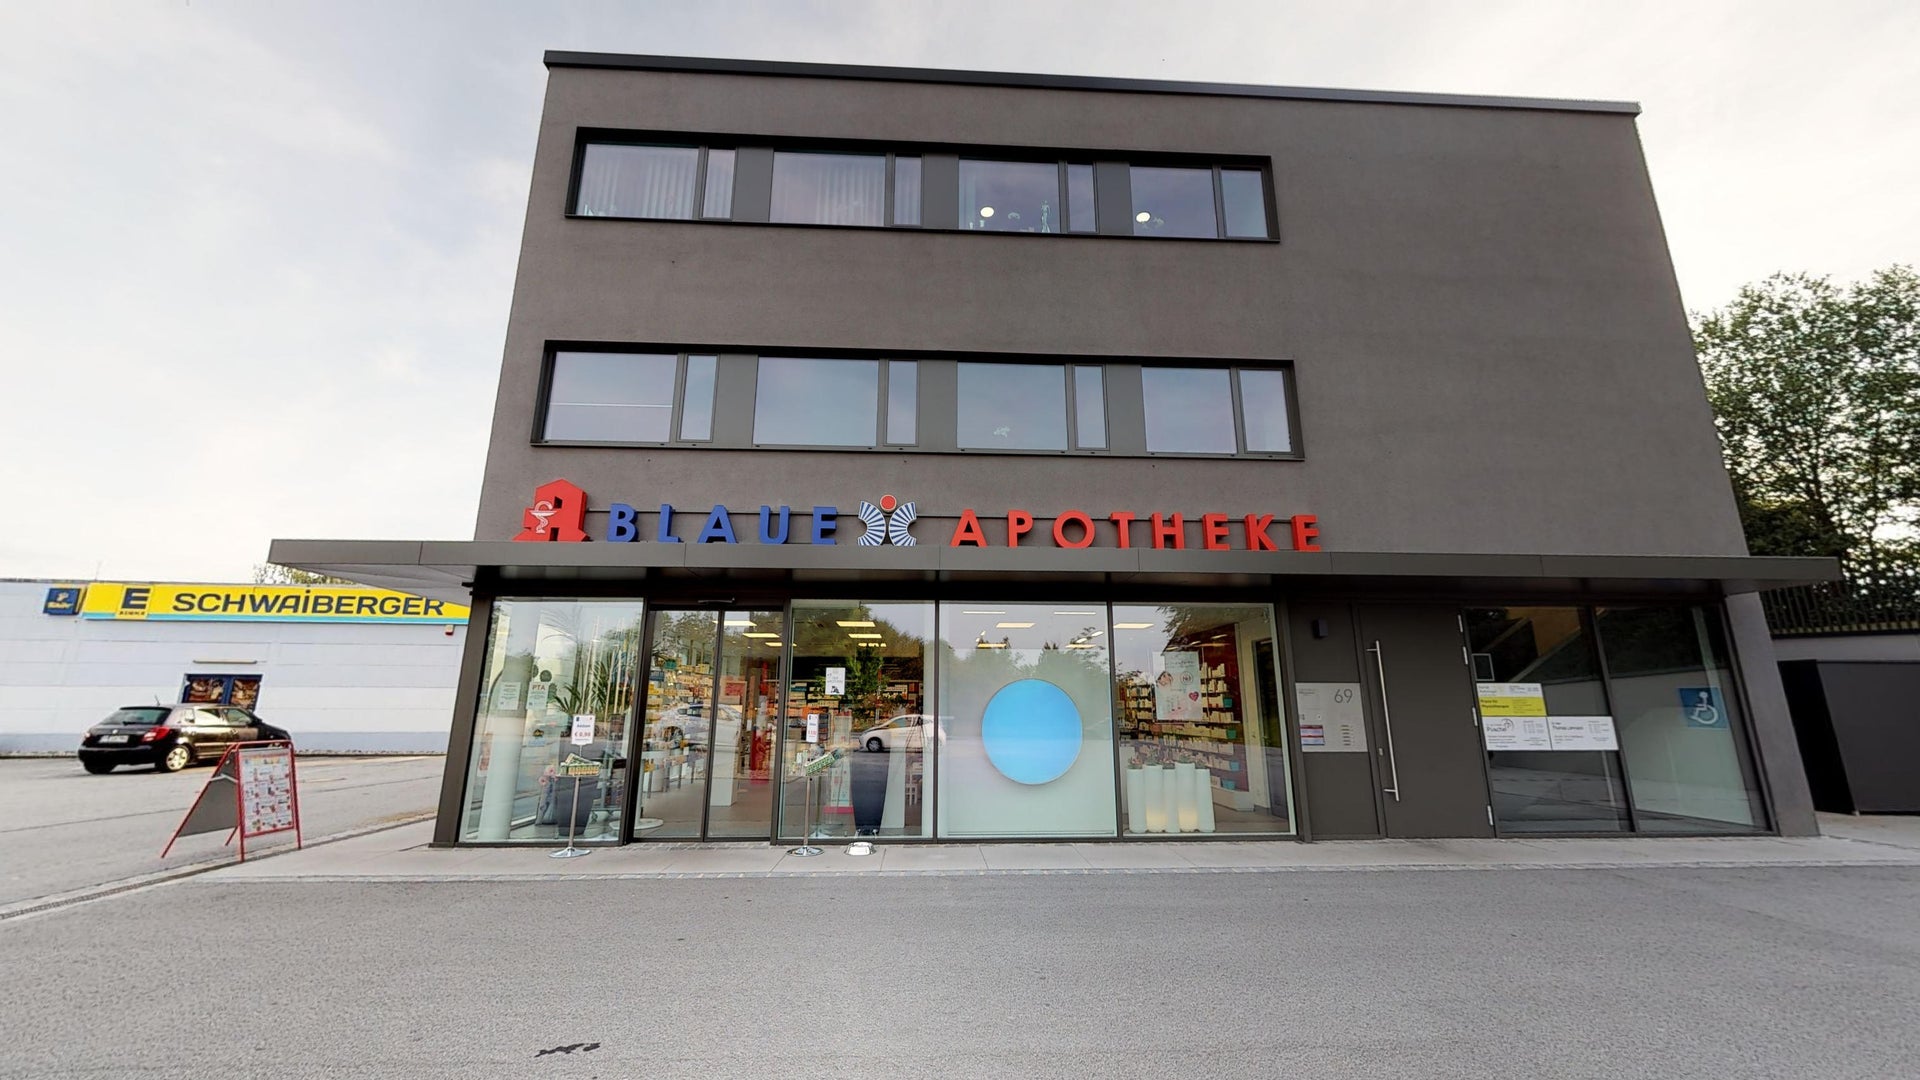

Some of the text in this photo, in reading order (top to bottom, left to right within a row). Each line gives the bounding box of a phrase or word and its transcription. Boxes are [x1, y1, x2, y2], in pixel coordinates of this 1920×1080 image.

[606, 502, 1323, 552] BLAUE APOTHEKE
[1334, 688, 1354, 704] 69
